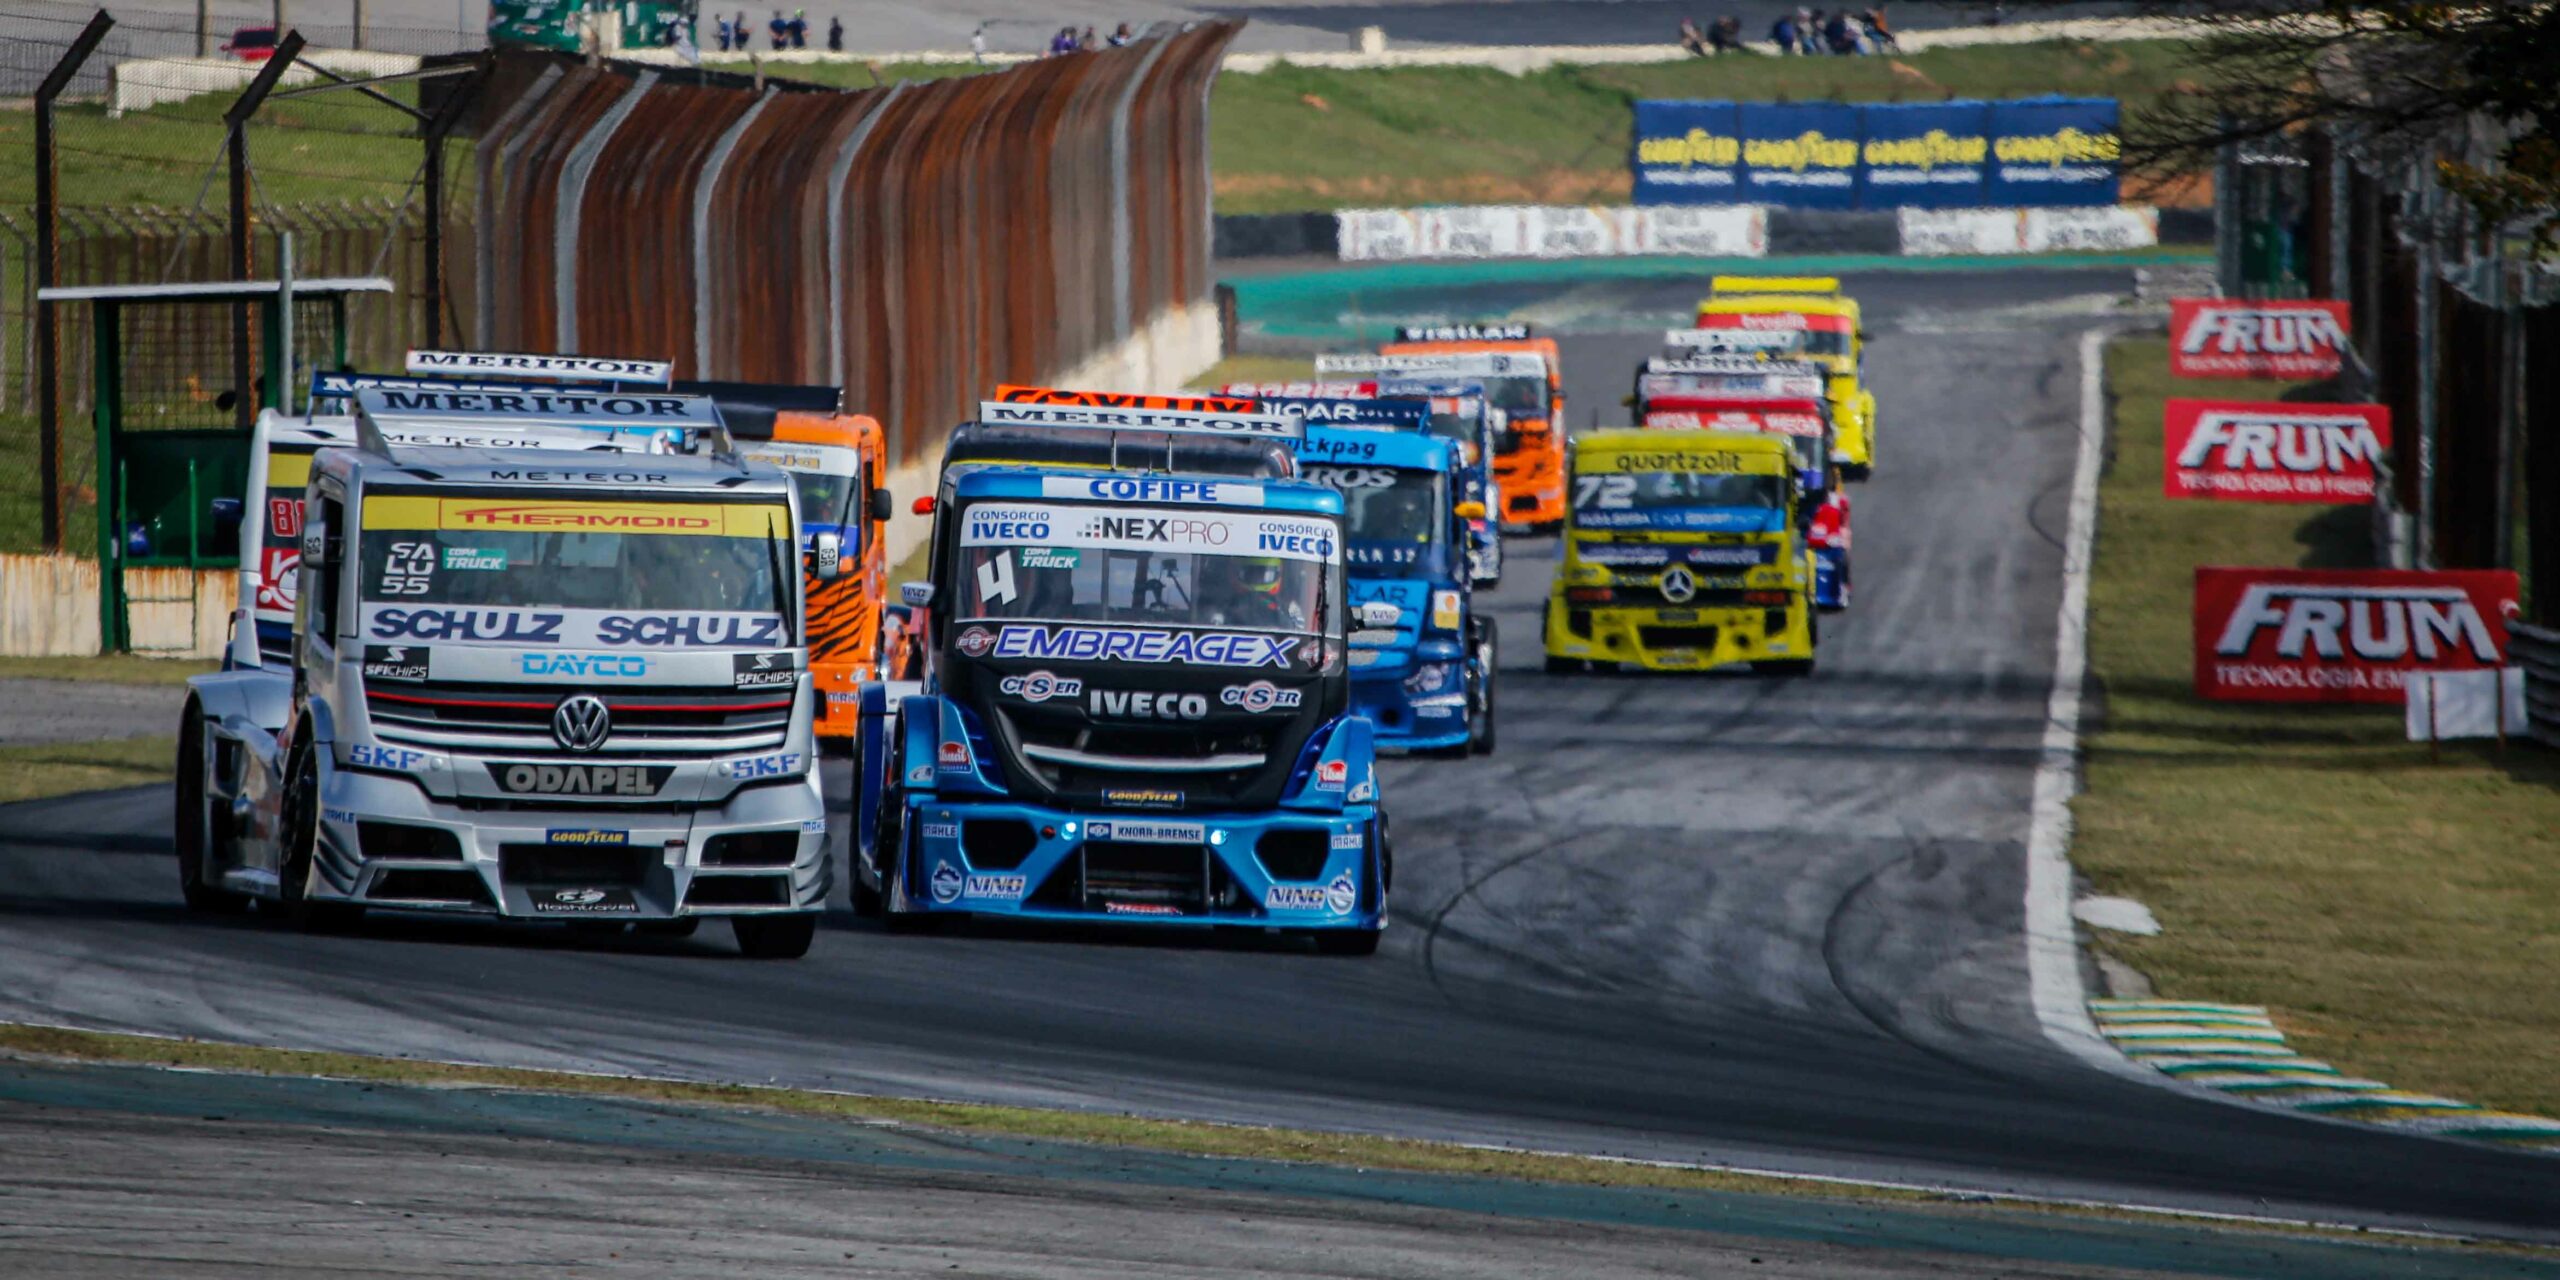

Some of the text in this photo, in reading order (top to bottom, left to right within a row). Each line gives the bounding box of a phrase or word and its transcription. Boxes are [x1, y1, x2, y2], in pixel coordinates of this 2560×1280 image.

[2180, 308, 2347, 354] FRUM
[416, 354, 656, 376] MERITOR
[380, 391, 691, 417] MERITOR
[992, 408, 1288, 433] MERITOR
[382, 433, 541, 449] METEOR
[2177, 410, 2384, 471] FRUM
[1615, 452, 1743, 473] quartzolit
[491, 470, 668, 484] METEOR
[1089, 480, 1218, 501] COFIPE
[1576, 475, 1638, 510] 72
[460, 508, 711, 528] THERMOID
[1102, 516, 1229, 545] NEXPRO
[971, 523, 1050, 539] IVECO
[1258, 534, 1334, 557] IVECO
[446, 557, 503, 570] TRUCK
[1022, 556, 1078, 569] TRUCK
[976, 550, 1018, 605] 4
[370, 608, 564, 643] SCHULZ
[596, 616, 779, 647] SCHULZ
[2215, 583, 2501, 662] FRUM
[994, 625, 1299, 669] EMBREAGEX
[520, 655, 648, 677] DAYCO
[2215, 664, 2369, 689] TECNOLOGIA
[1002, 672, 1081, 700] CISER
[1222, 681, 1301, 711] CISER
[1089, 690, 1207, 719] IVECO
[350, 744, 425, 769] SKF
[732, 753, 800, 780] SKF
[505, 764, 655, 795] ODAPEL
[1107, 789, 1178, 803] GOODYEAR
[551, 830, 625, 845] GOODYEAR
[923, 824, 958, 838] MAHLE
[1117, 825, 1201, 842] KNORR-BREMSE
[966, 876, 1024, 892] NINO
[1270, 887, 1325, 904] NINO
